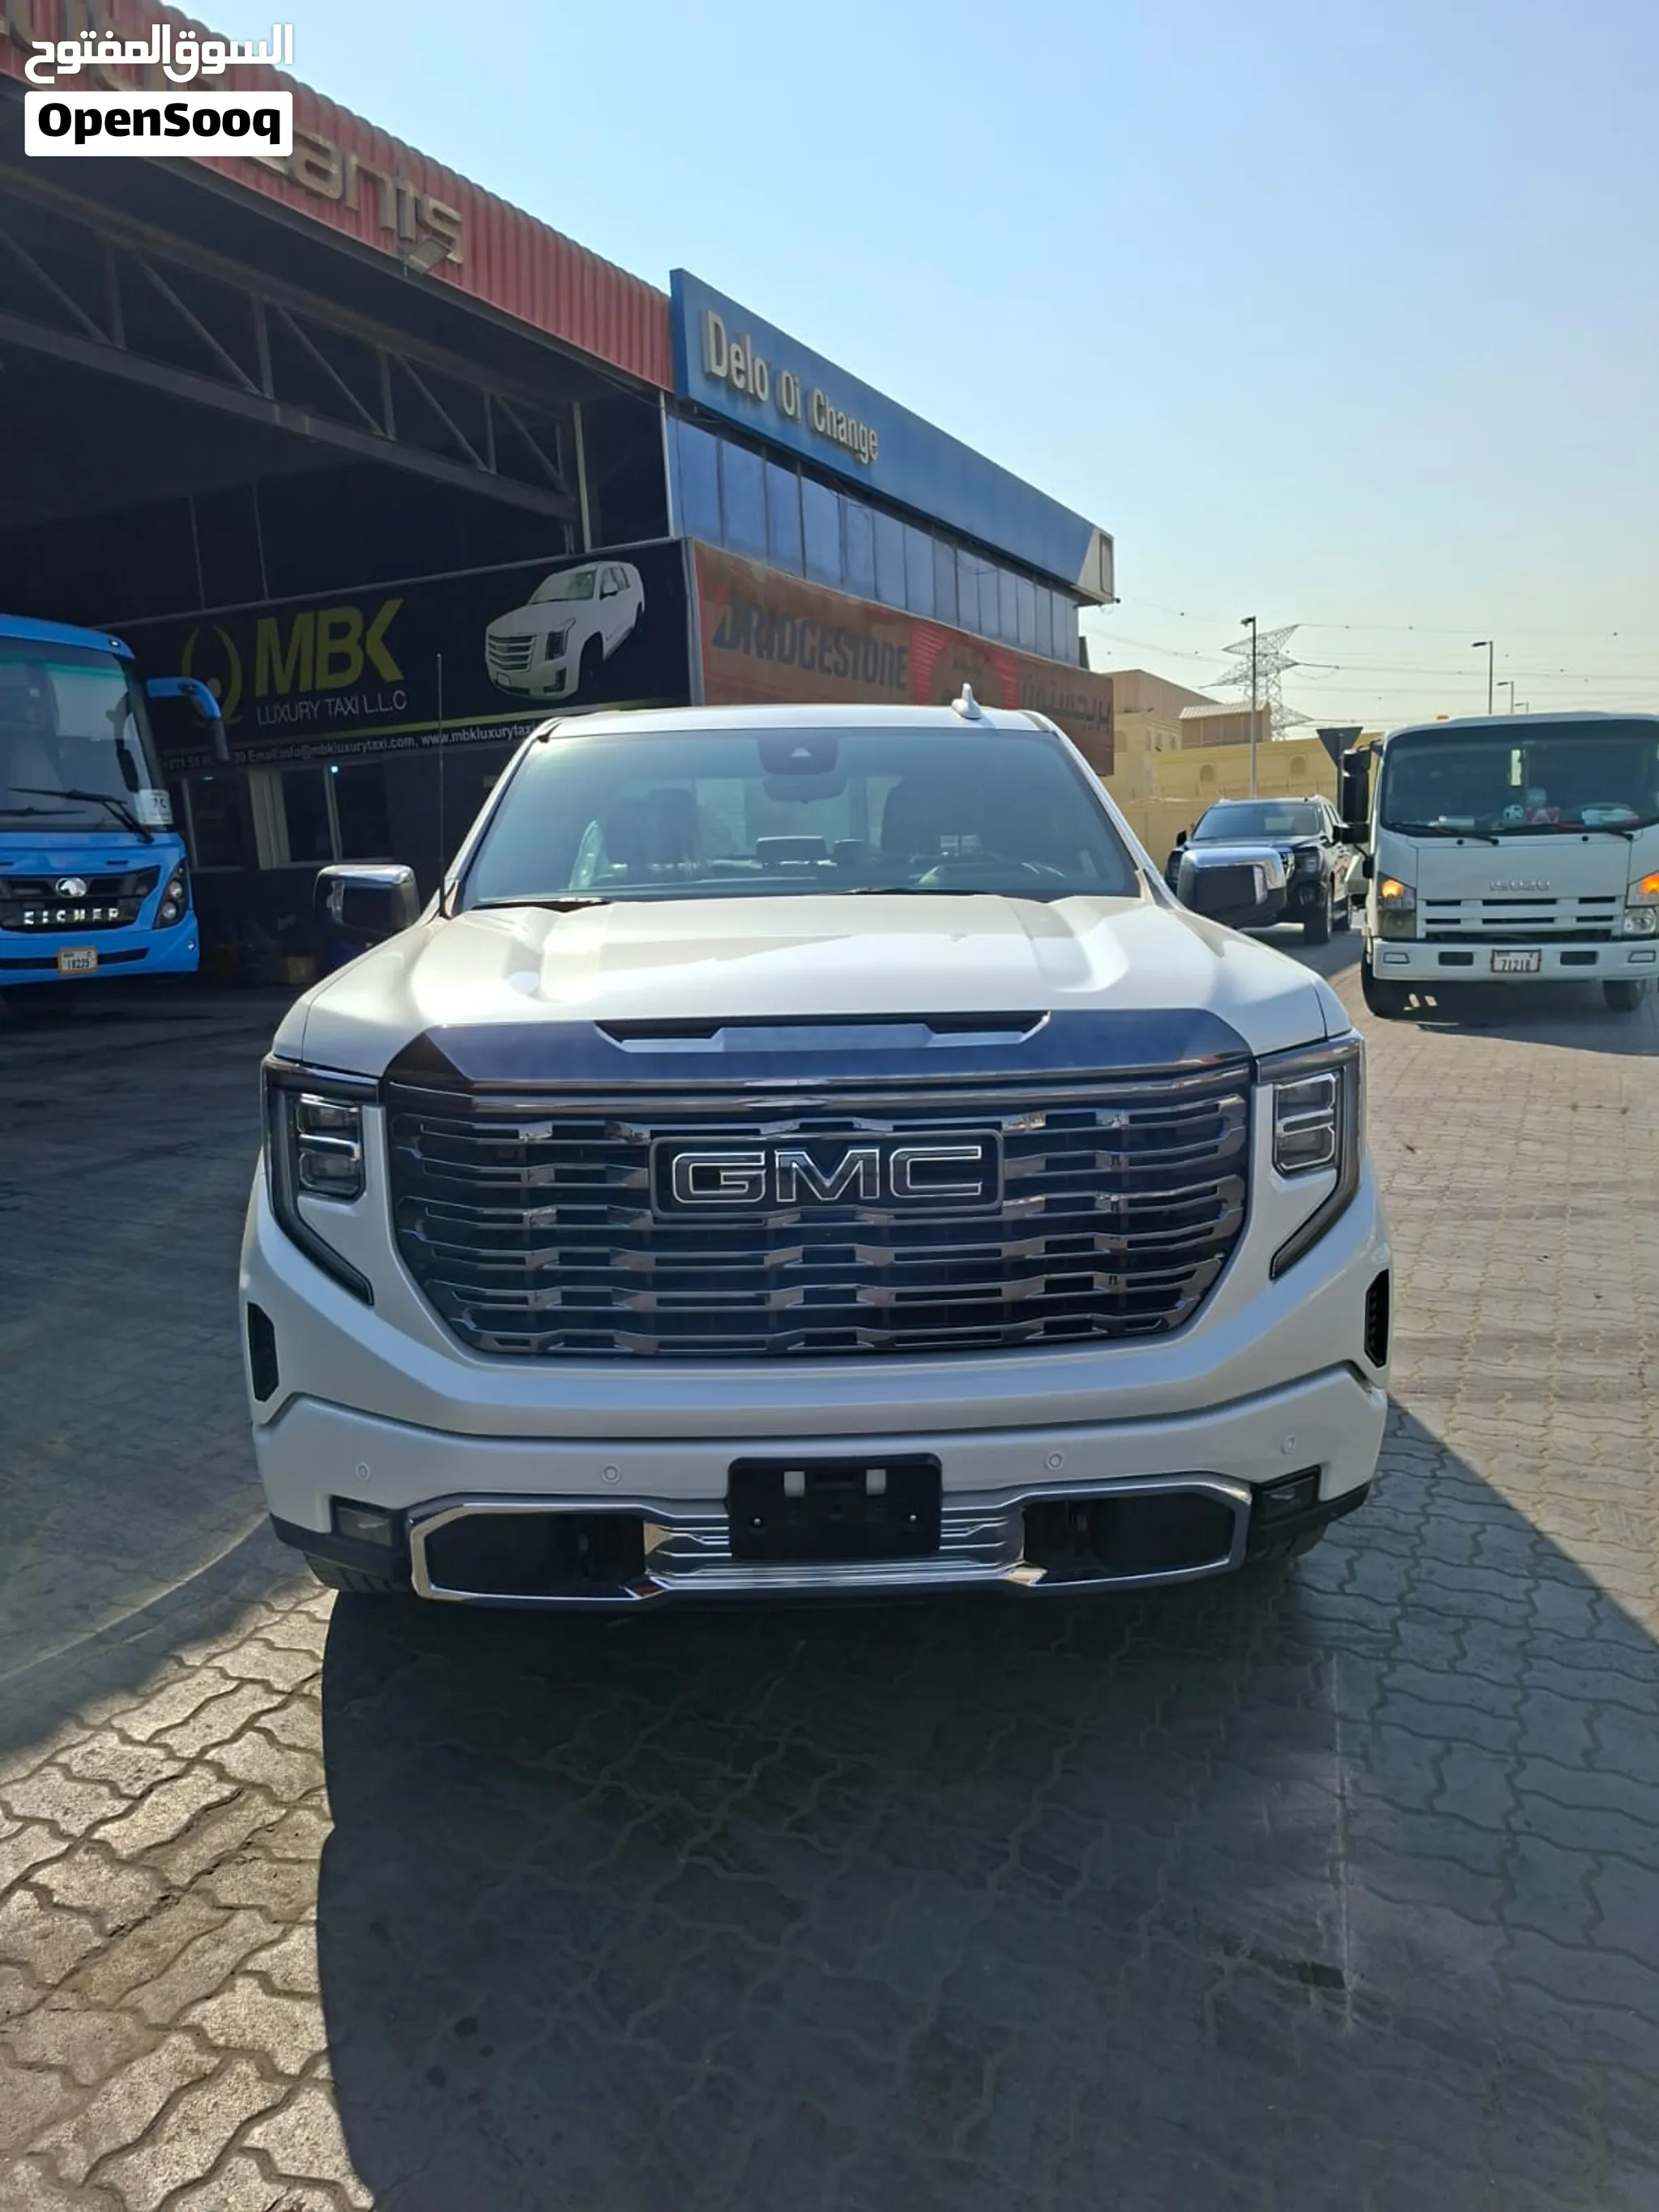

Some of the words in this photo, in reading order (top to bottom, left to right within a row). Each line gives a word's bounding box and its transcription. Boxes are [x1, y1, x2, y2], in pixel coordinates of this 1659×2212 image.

[702, 310, 769, 401] Delo
[807, 387, 878, 464] Change
[255, 597, 404, 697] MBK
[257, 700, 320, 725] LUXURY
[324, 694, 359, 718] TAXI
[23, 908, 119, 924] EICHER
[672, 1145, 982, 1204] GMC
